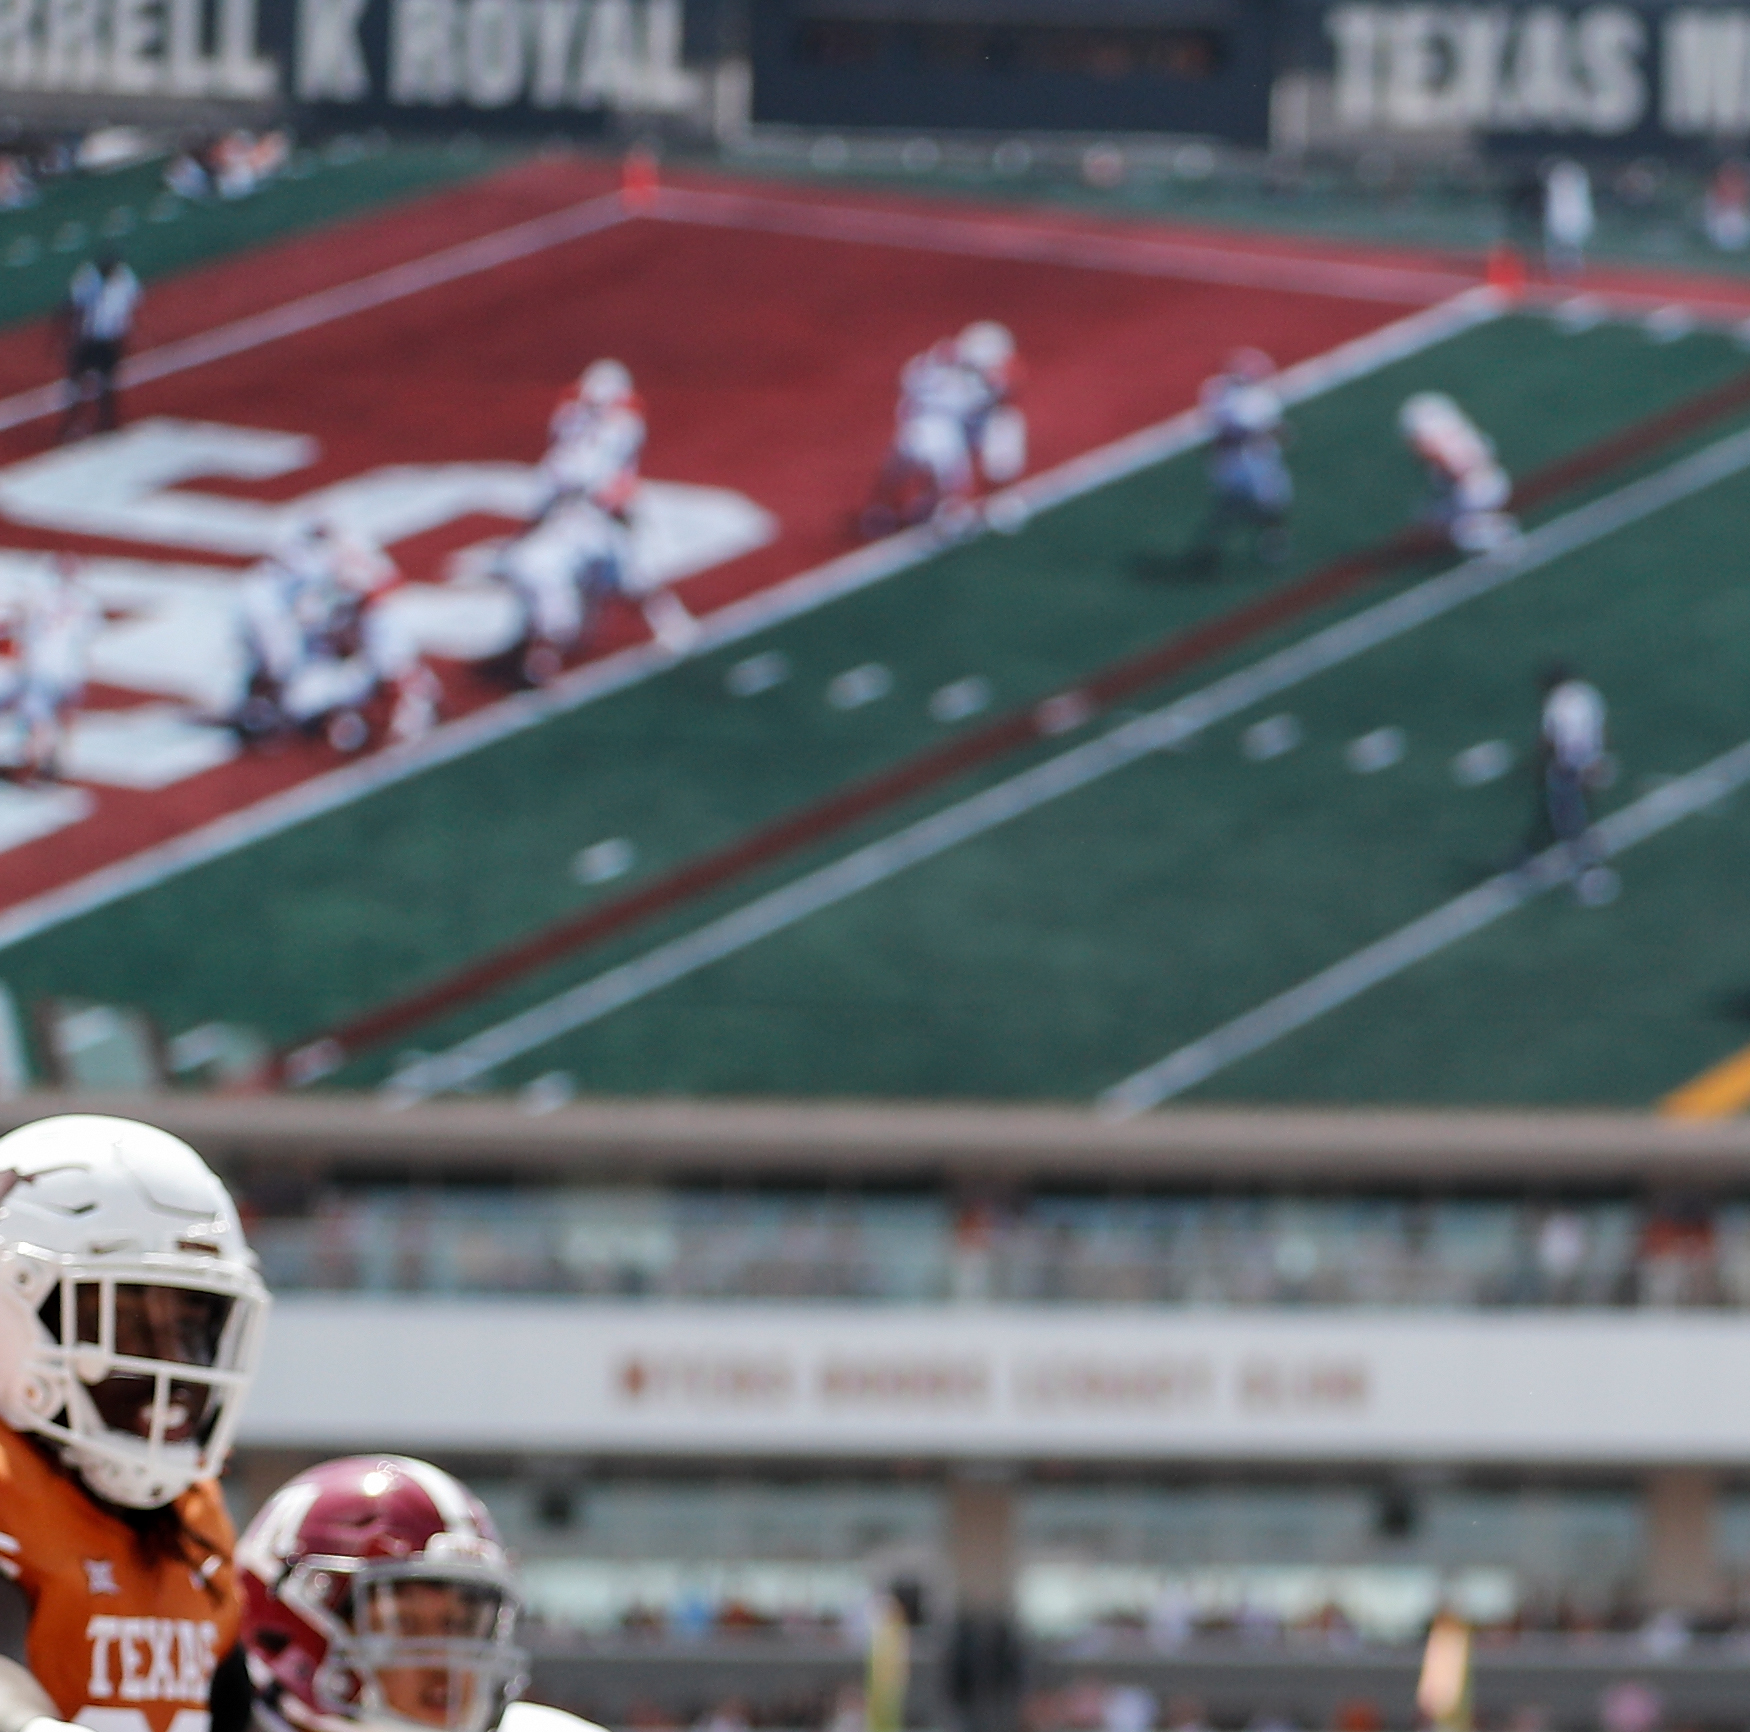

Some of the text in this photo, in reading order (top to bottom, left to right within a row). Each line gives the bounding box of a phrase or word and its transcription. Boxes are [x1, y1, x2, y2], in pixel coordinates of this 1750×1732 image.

[297, 0, 373, 104] K
[388, 0, 708, 112] ROYAL
[1323, 8, 1648, 136] TEXAS
